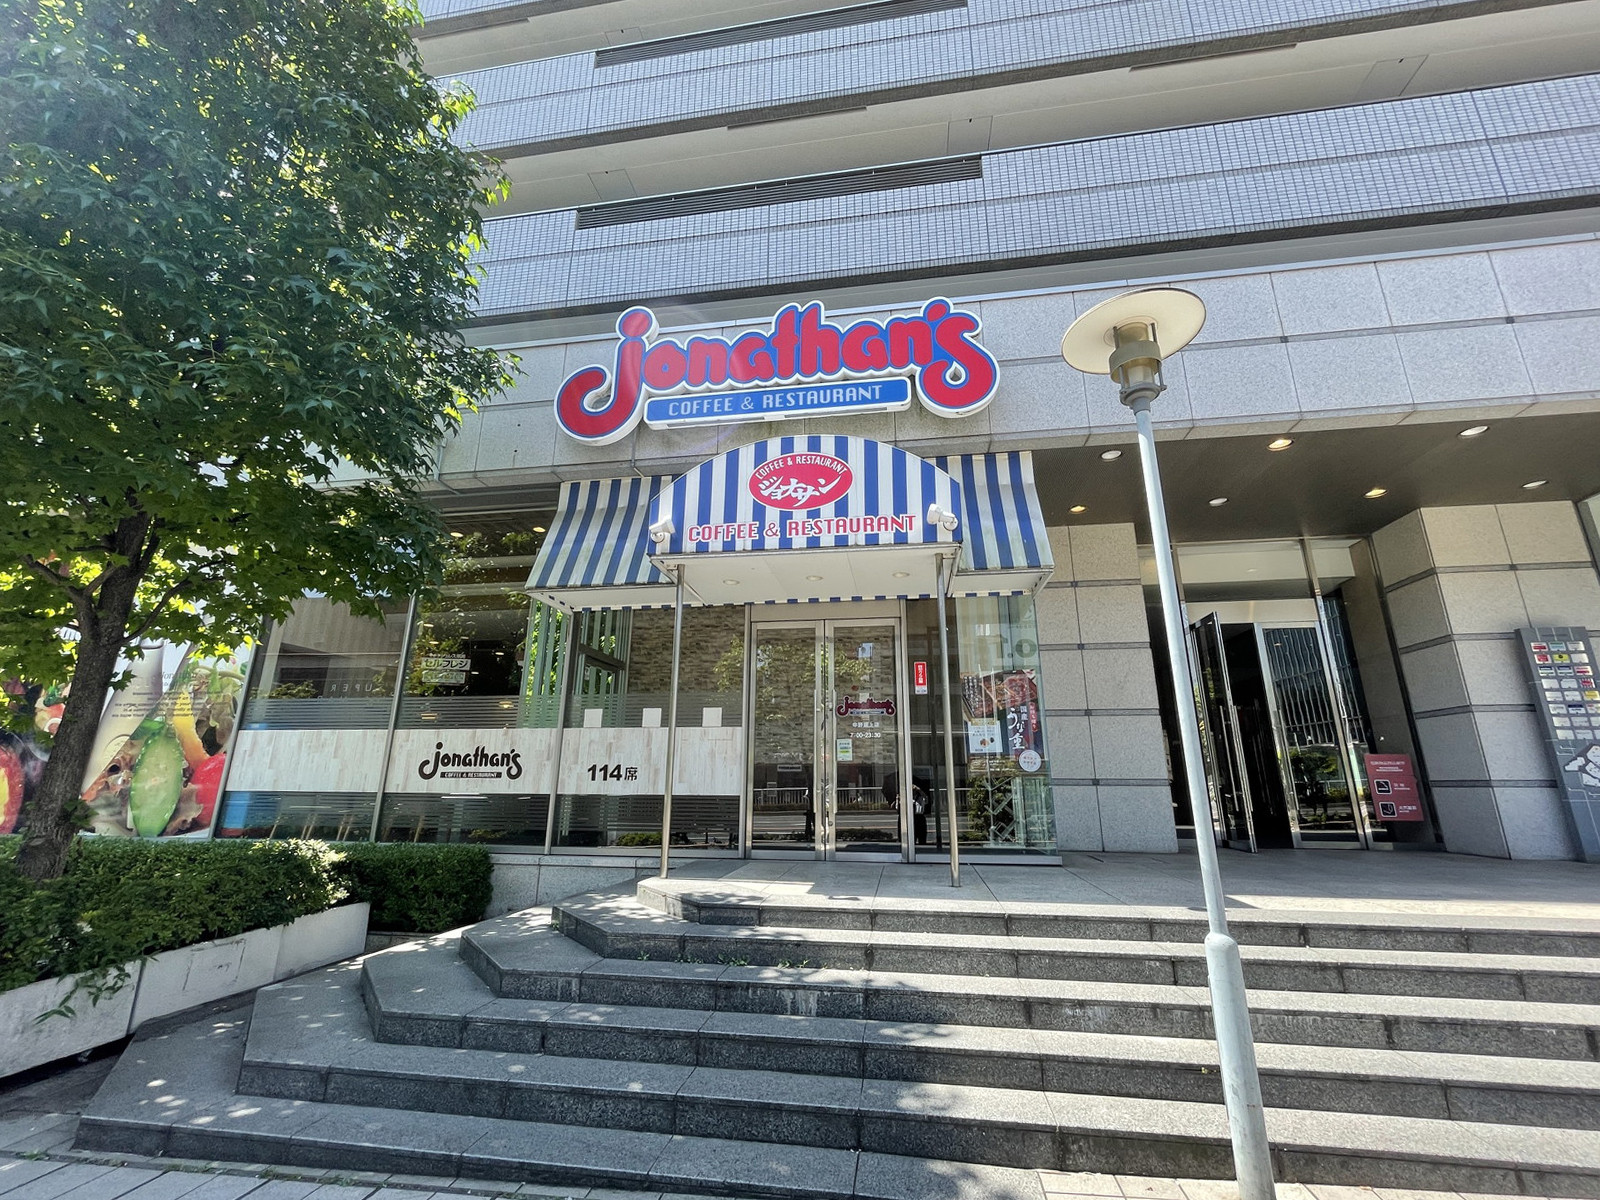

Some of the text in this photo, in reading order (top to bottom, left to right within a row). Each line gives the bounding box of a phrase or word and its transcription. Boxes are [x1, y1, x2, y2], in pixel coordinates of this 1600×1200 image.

[556, 302, 997, 439] jonathan's
[668, 384, 884, 417] COFFEE & RESTAURANT
[754, 455, 848, 480] COFFEE & RESTAURANT
[757, 475, 842, 508] ジョナサン
[687, 514, 917, 543] COFFEE & RESTAURANT
[1006, 707, 1026, 750] うな重
[418, 741, 523, 780] jonathan's
[587, 764, 638, 781] 114席
